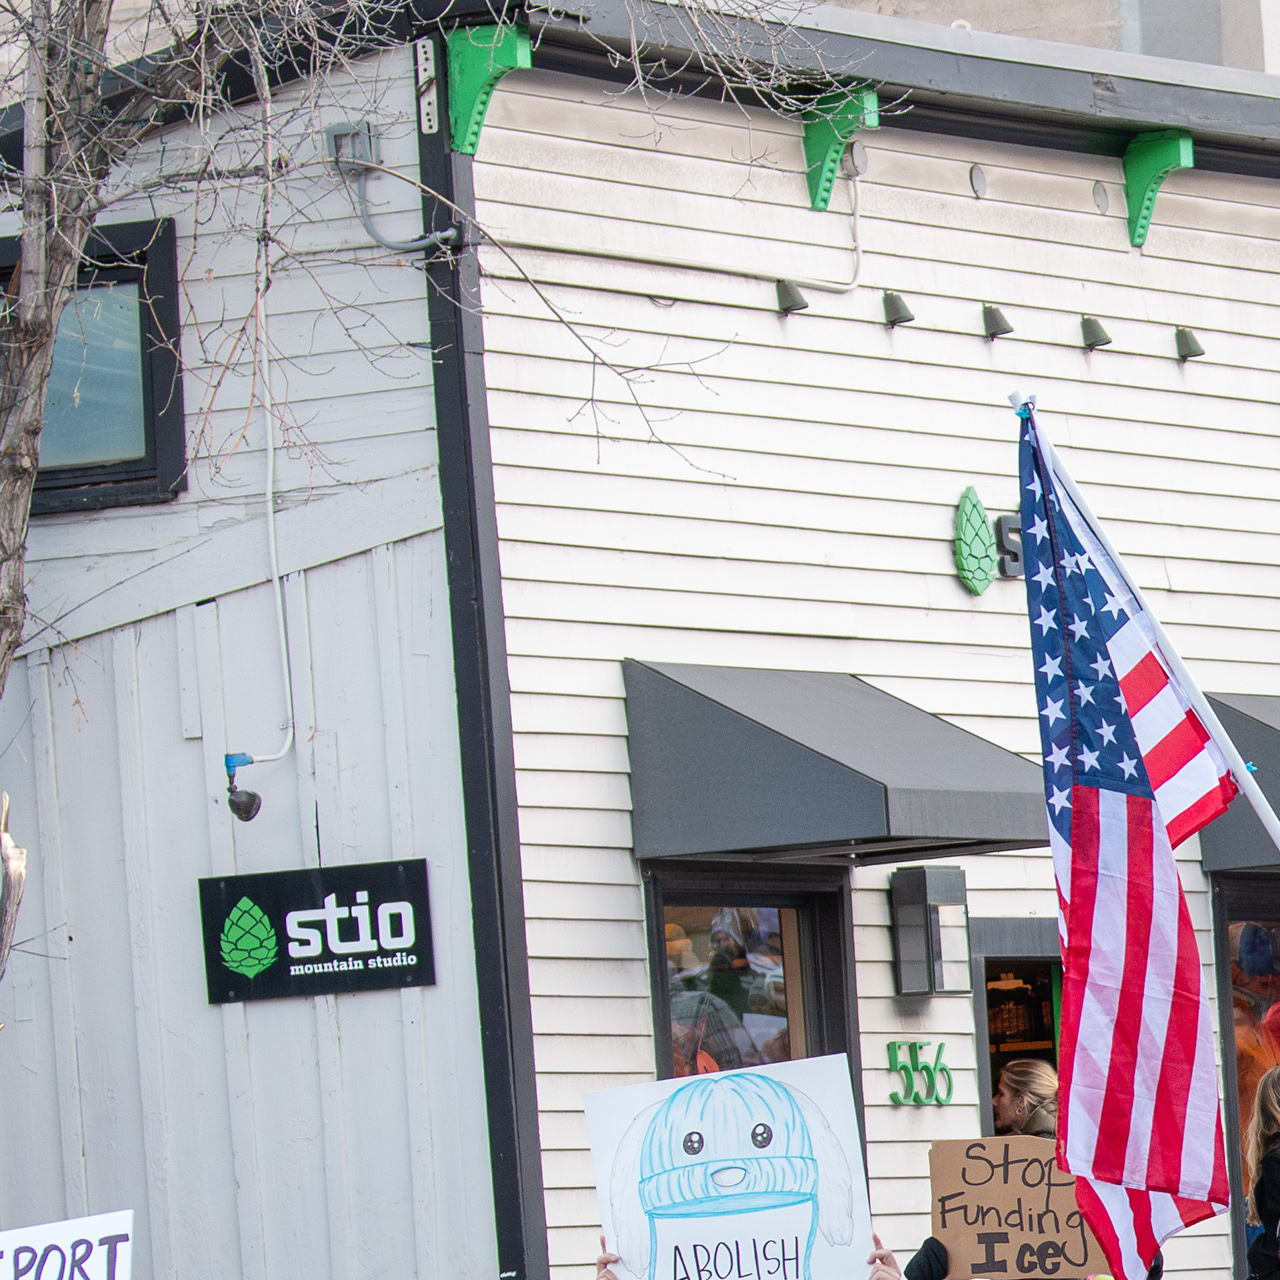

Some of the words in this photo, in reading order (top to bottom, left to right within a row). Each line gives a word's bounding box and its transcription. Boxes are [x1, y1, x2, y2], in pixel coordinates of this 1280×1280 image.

[285, 890, 416, 958] stio
[290, 957, 364, 976] mountain
[367, 952, 418, 969] studio
[887, 1041, 954, 1106] 556
[962, 1142, 1076, 1212] Stop
[938, 1190, 1089, 1268] Funding
